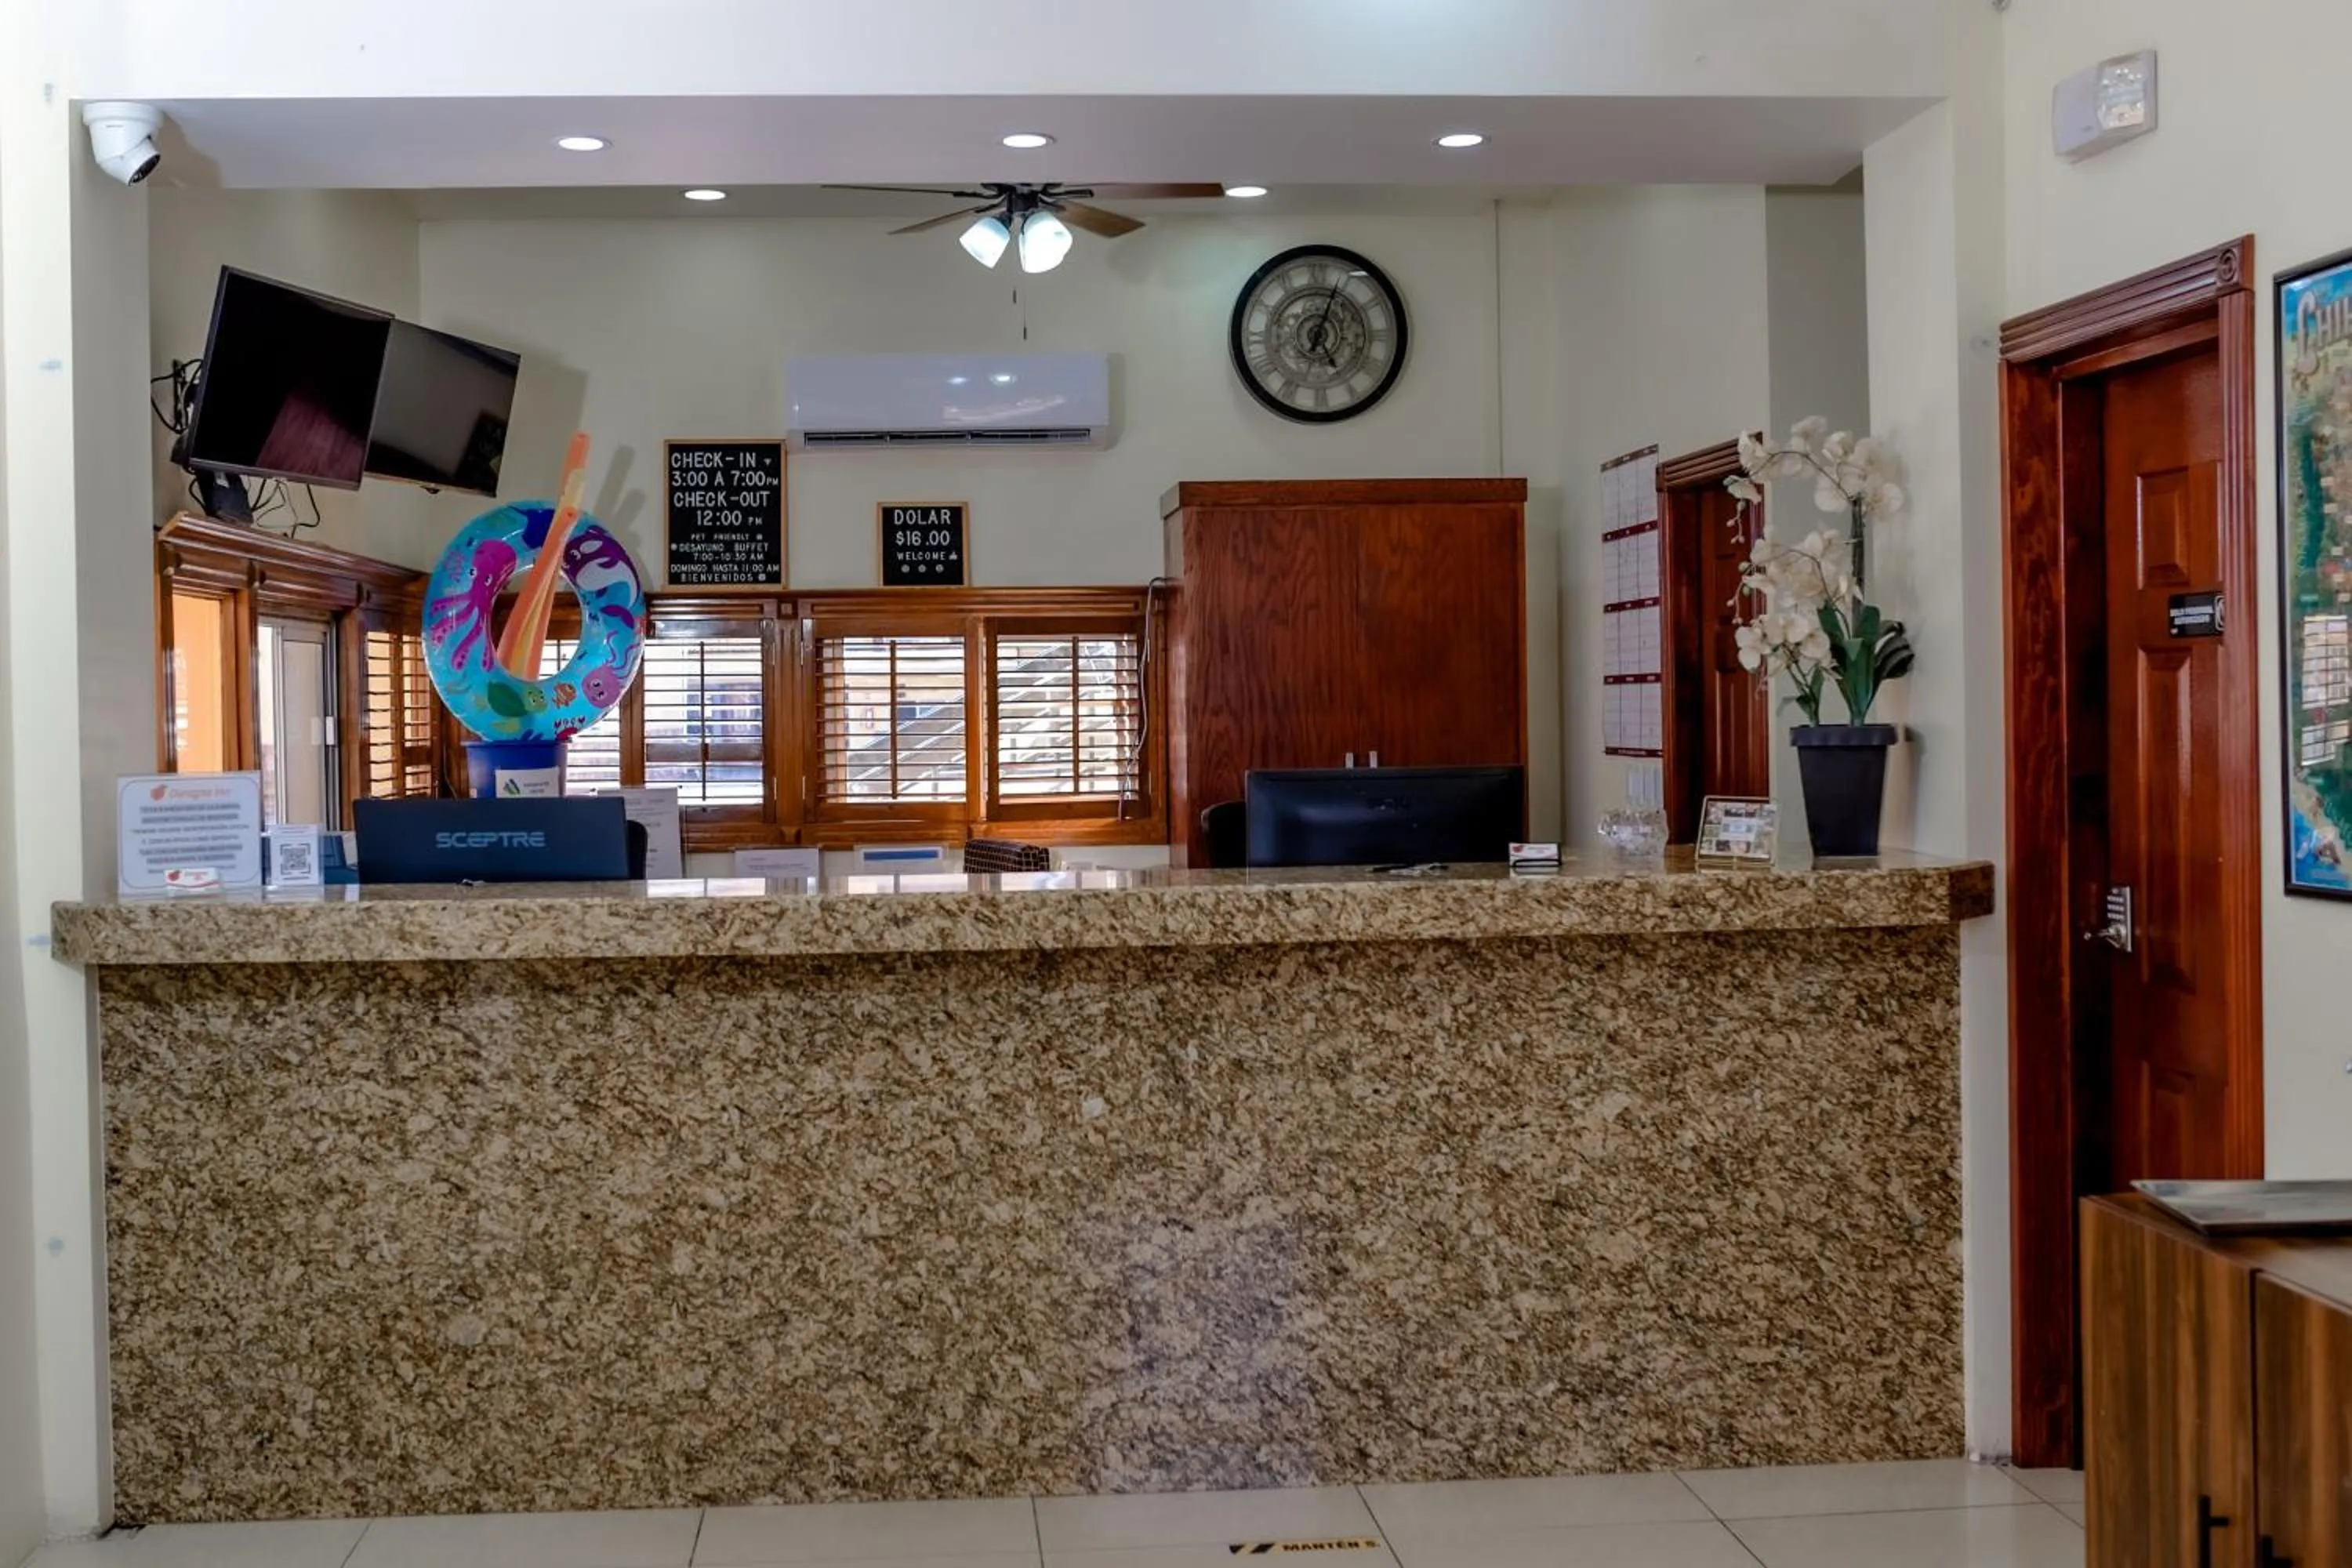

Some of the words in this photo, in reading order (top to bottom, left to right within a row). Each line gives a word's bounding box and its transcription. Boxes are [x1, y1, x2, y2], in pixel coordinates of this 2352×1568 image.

[672, 470, 708, 486] 3:00
[714, 470, 725, 486] A
[673, 491, 771, 507] CHECK-OUT
[697, 510, 742, 526] 12:00
[748, 517, 763, 526] PM
[895, 509, 952, 524] DOLAR
[895, 530, 950, 546] $16.00
[679, 543, 724, 552] DESAYUNO
[734, 542, 768, 552] BUFFET
[750, 553, 764, 561] AM
[896, 551, 946, 561] WELCOME
[670, 564, 707, 573] DOMINGO
[713, 564, 739, 573] HASTA
[766, 564, 780, 573] AM
[680, 573, 753, 583] BIENVENIDOS
[436, 832, 546, 848] SCEPTRE
